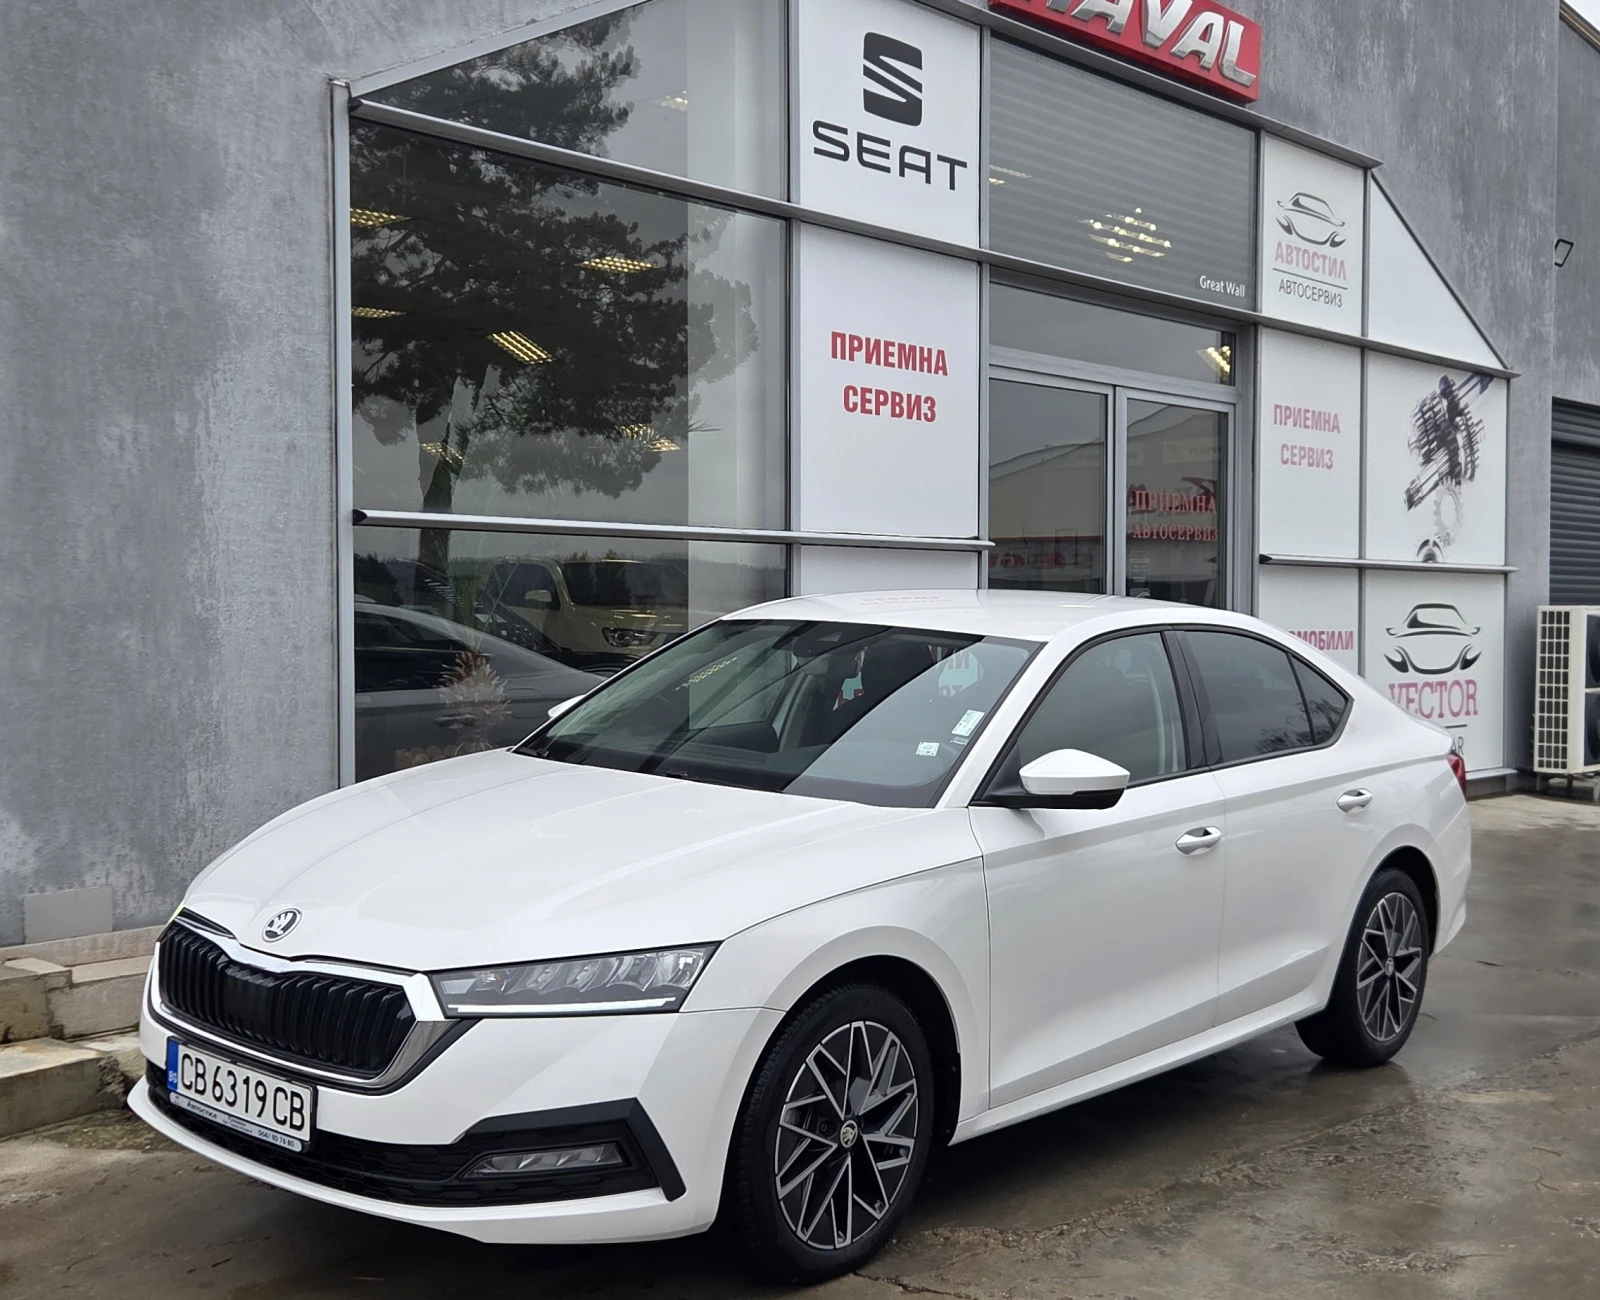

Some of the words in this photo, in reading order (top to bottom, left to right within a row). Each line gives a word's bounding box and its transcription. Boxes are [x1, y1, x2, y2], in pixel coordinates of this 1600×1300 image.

[1025, 0, 1256, 87] AVAL
[812, 120, 967, 191] SEAT
[1275, 241, 1347, 281] АВТОСТИЛ
[1200, 275, 1224, 293] Great
[1226, 281, 1245, 298] Wall
[1279, 278, 1343, 308] АВТОСЕРВИЗ
[831, 331, 948, 376] ПРИЕМНА
[843, 385, 937, 423] СЕРВИЗ
[1274, 404, 1341, 434] ПРИЕМНА
[1280, 443, 1334, 470] СЕРВИЗ
[1134, 490, 1217, 514] ПРИЕМНА
[1132, 523, 1218, 541] АВТОСЕРВИЗ
[1388, 679, 1478, 719] VECTOR
